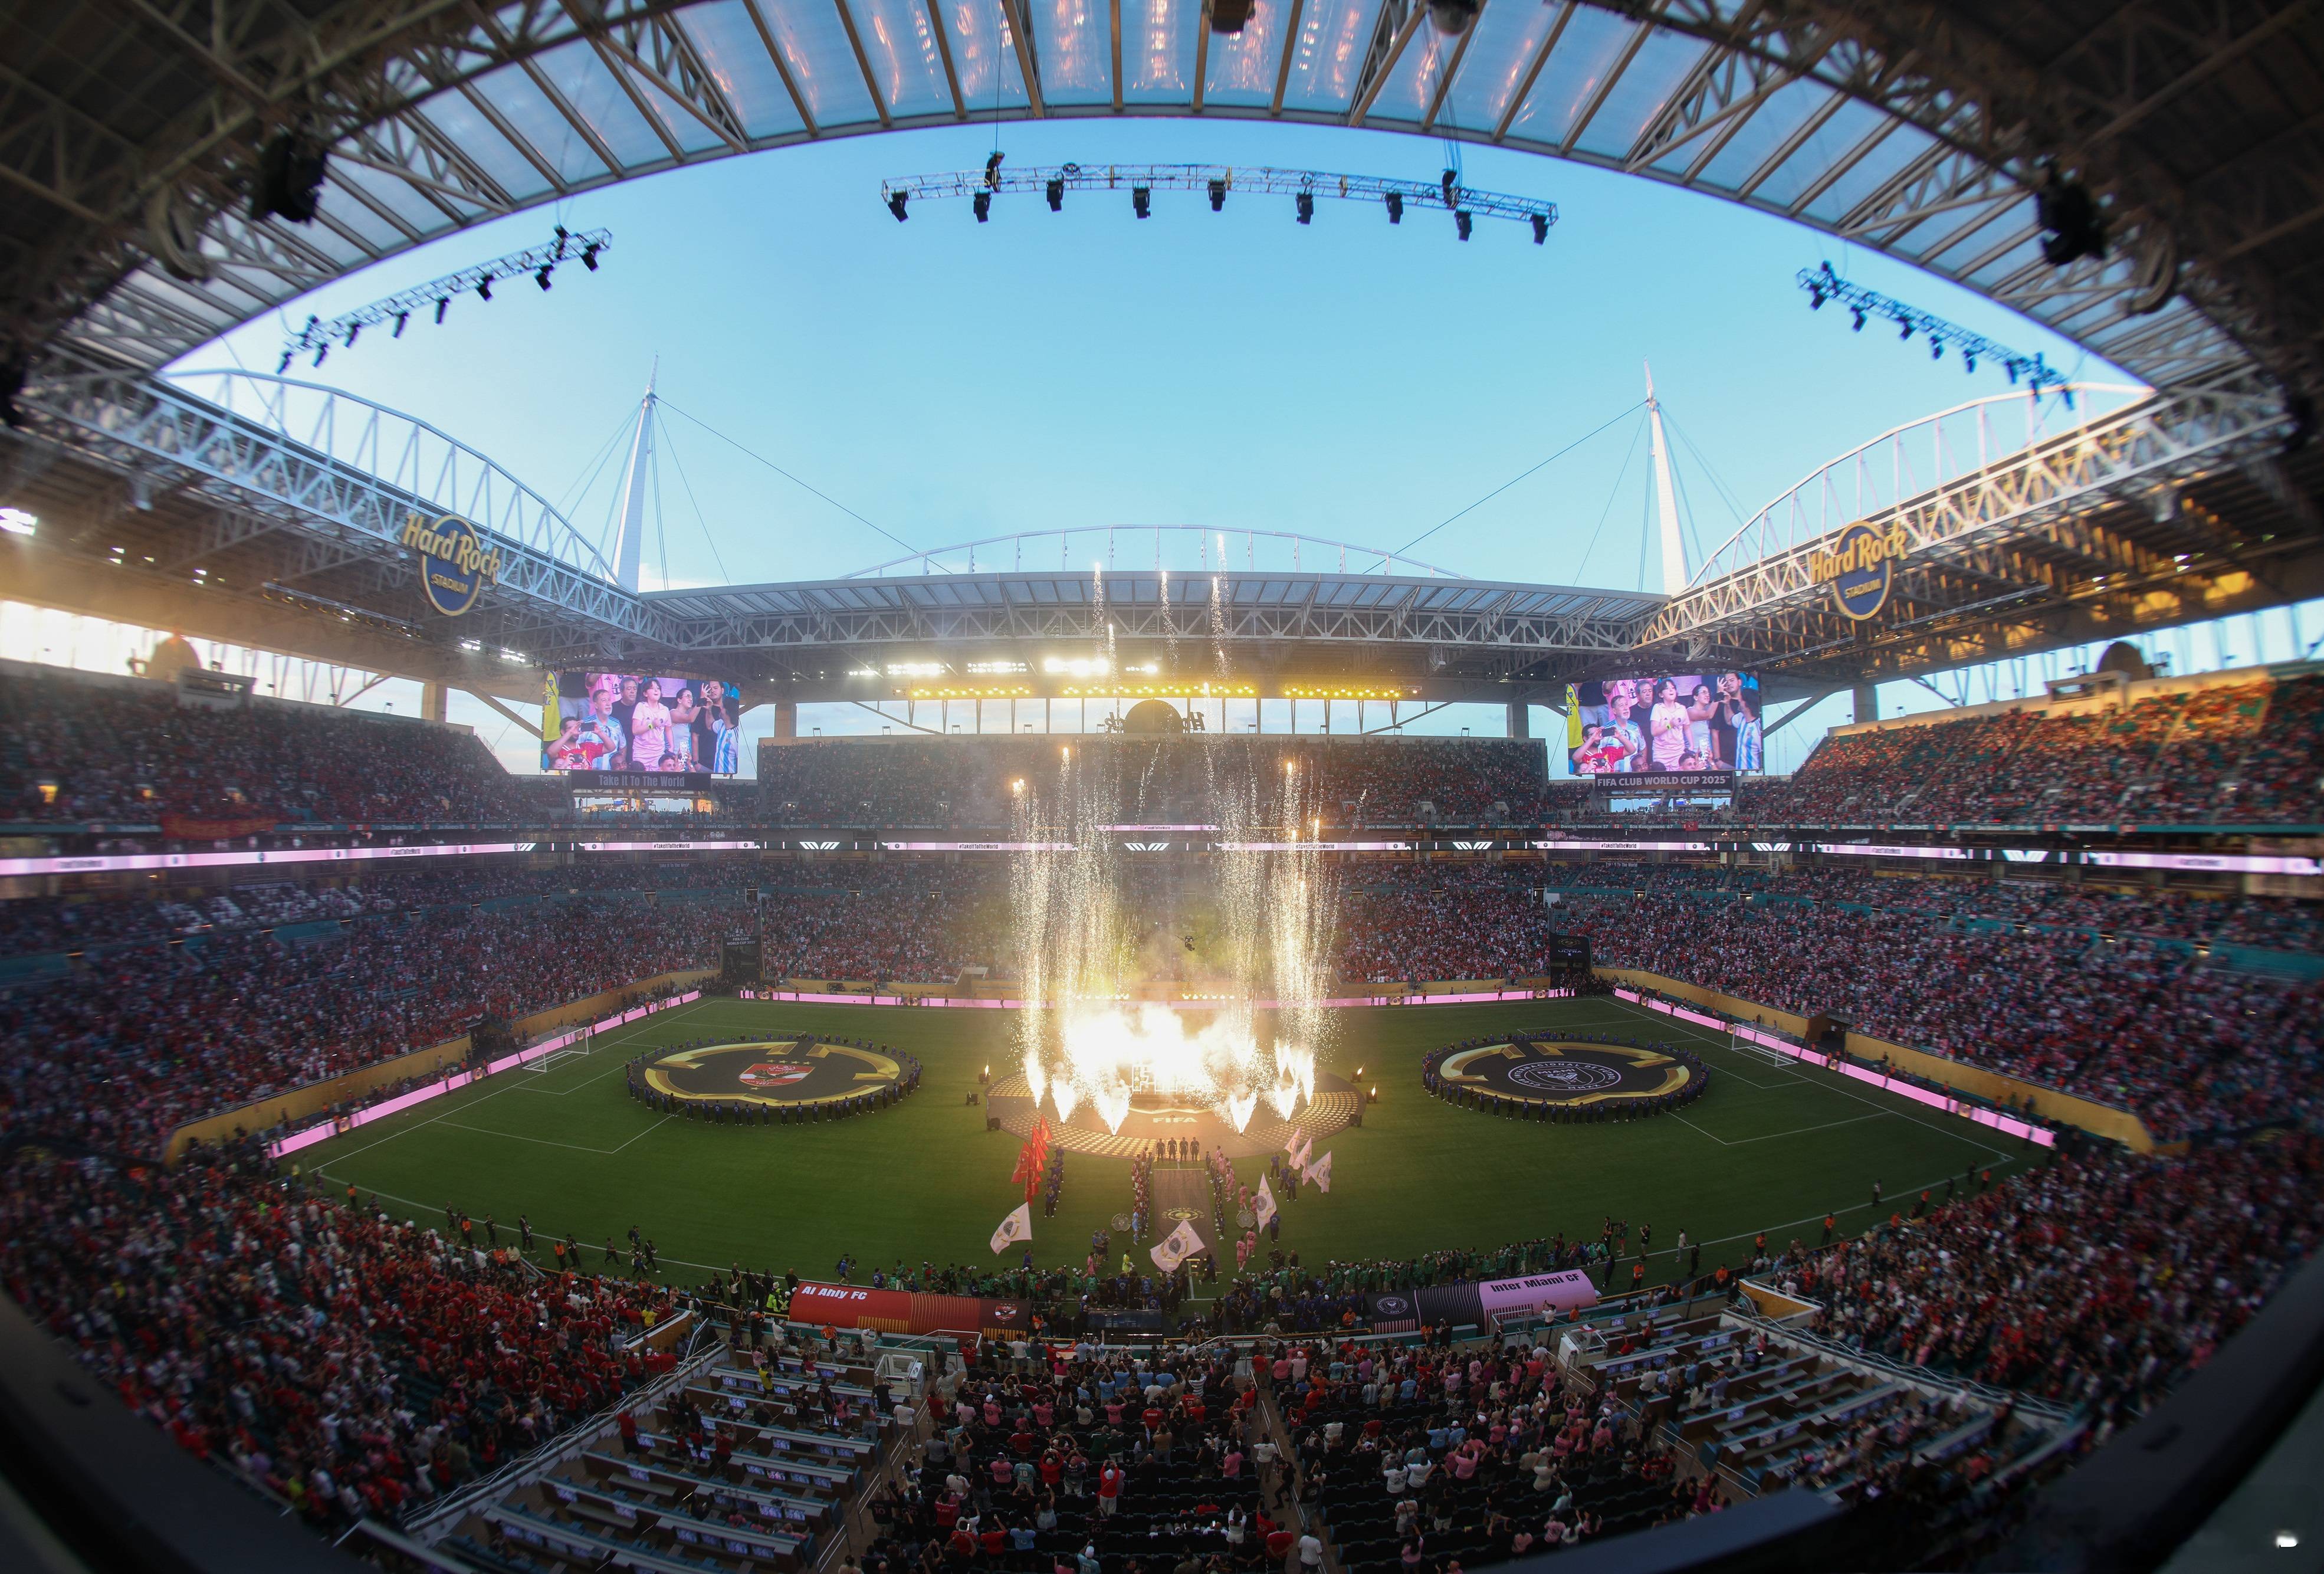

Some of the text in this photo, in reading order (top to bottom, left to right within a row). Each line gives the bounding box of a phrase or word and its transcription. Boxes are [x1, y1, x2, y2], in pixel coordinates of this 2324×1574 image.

[402, 513, 501, 585] Hard Rock
[1811, 522, 1909, 584] Hard Rock
[431, 573, 468, 595] STADIUM
[1845, 579, 1882, 599] STADIUM
[599, 775, 685, 787] Take It To The World
[1597, 778, 1617, 786] FIFA
[1619, 777, 1642, 786] CLUB
[1644, 776, 1678, 785] WORLD
[1680, 776, 1699, 785] CUP
[802, 1286, 868, 1300] Al Ahly FC
[1490, 1273, 1582, 1293] Inter Miami CF
